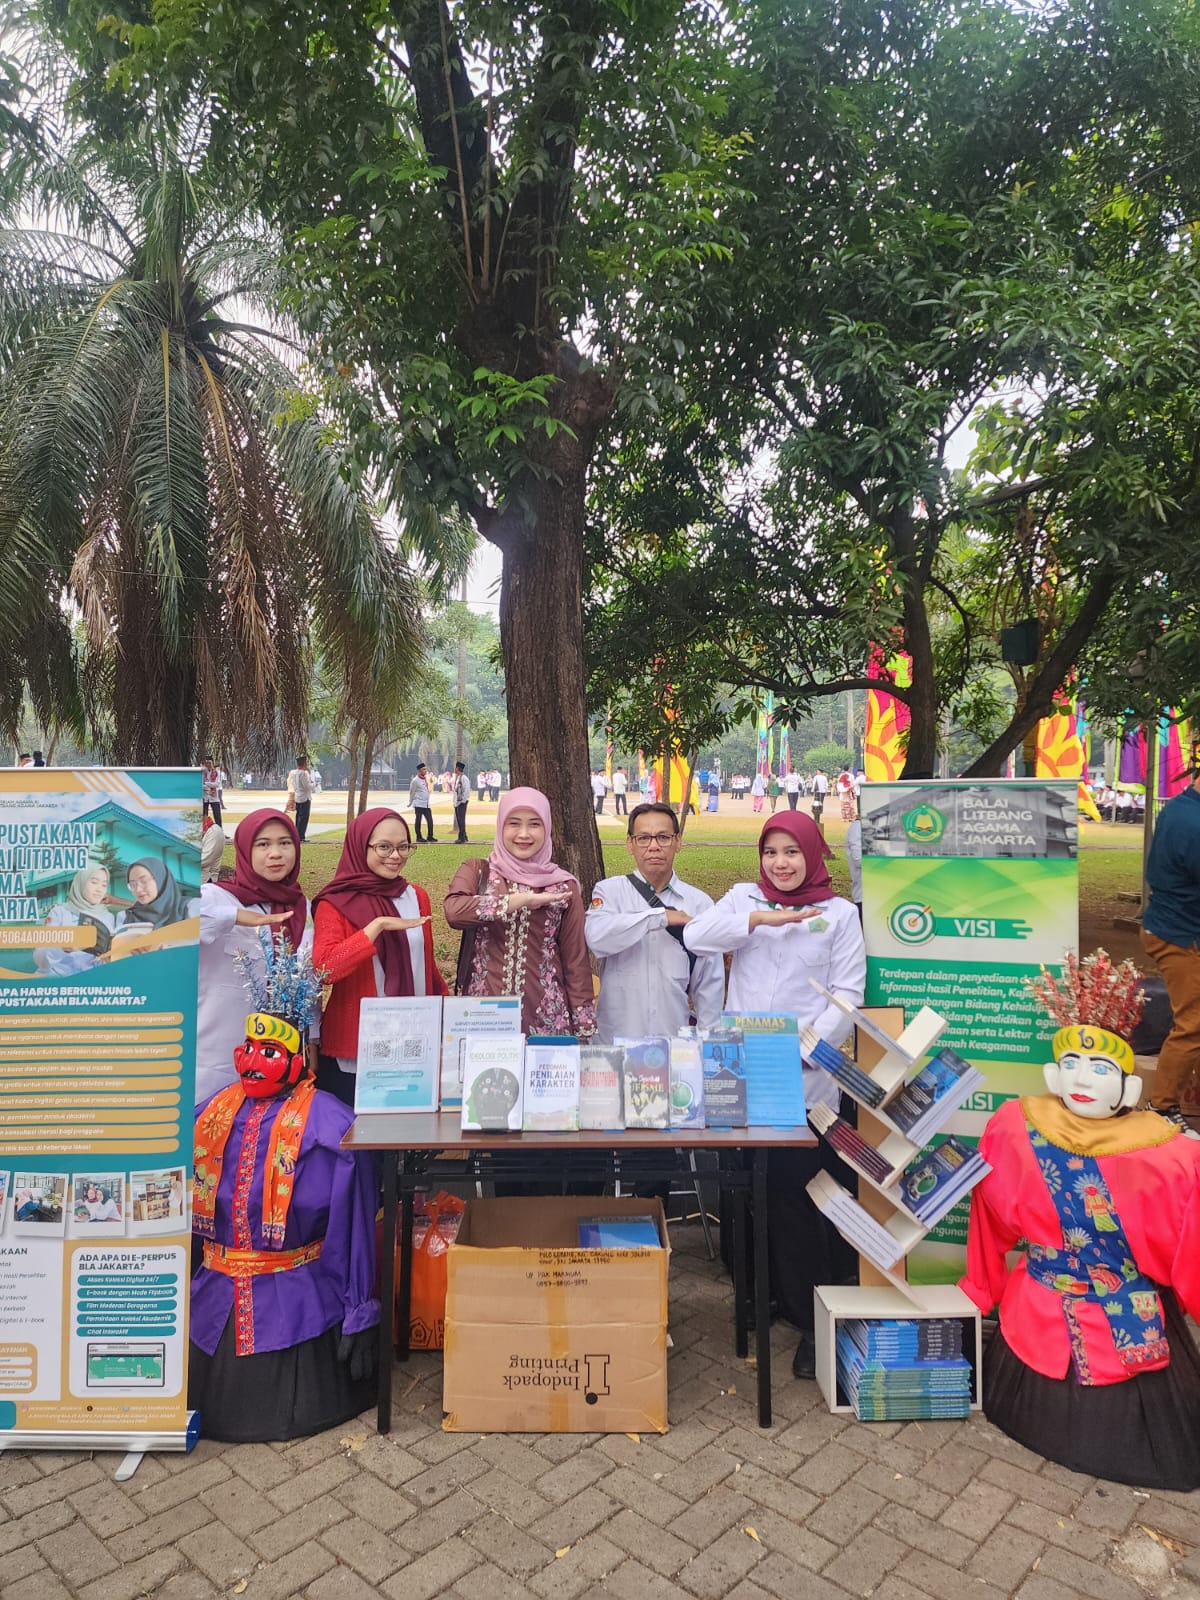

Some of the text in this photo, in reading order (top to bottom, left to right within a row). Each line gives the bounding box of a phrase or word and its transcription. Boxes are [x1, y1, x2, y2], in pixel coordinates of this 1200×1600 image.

[962, 798, 1009, 809] BALAI
[962, 810, 1033, 821] LITBANG
[962, 823, 1021, 833] AGAMA
[963, 835, 1036, 846] JAKARTA
[17, 848, 87, 870] LITBANG
[954, 918, 996, 937] VISI
[879, 967, 924, 981] Terdepan
[926, 970, 957, 981] dalam
[958, 973, 1018, 984] penyediaan
[20, 987, 59, 996] HARUS
[60, 986, 132, 996] BERKUNJUNG
[880, 981, 926, 993] informasi
[927, 983, 951, 994] hasil
[952, 985, 1006, 998] Penelitian,
[69, 996, 90, 1006] BLA
[91, 996, 147, 1006] JAKARTA?
[887, 996, 963, 1010] pengembangan
[965, 999, 1001, 1012] Bidang
[735, 1016, 785, 1028] PENAMAS
[975, 1013, 1032, 1026] Pendidikan
[970, 1027, 997, 1037] serta
[998, 1028, 1032, 1039] Lektur
[969, 1040, 1030, 1053] Keagamaan
[530, 1070, 575, 1080] PENILAIAN
[529, 1079, 575, 1088] KARAKTER
[0, 1247, 28, 1255] KAAN
[79, 1252, 177, 1262] ADA APA DI E-PERPUS
[79, 1262, 145, 1271] BLA JAKARTA?
[509, 1354, 580, 1373] Printing
[502, 1370, 580, 1391] Indopack
